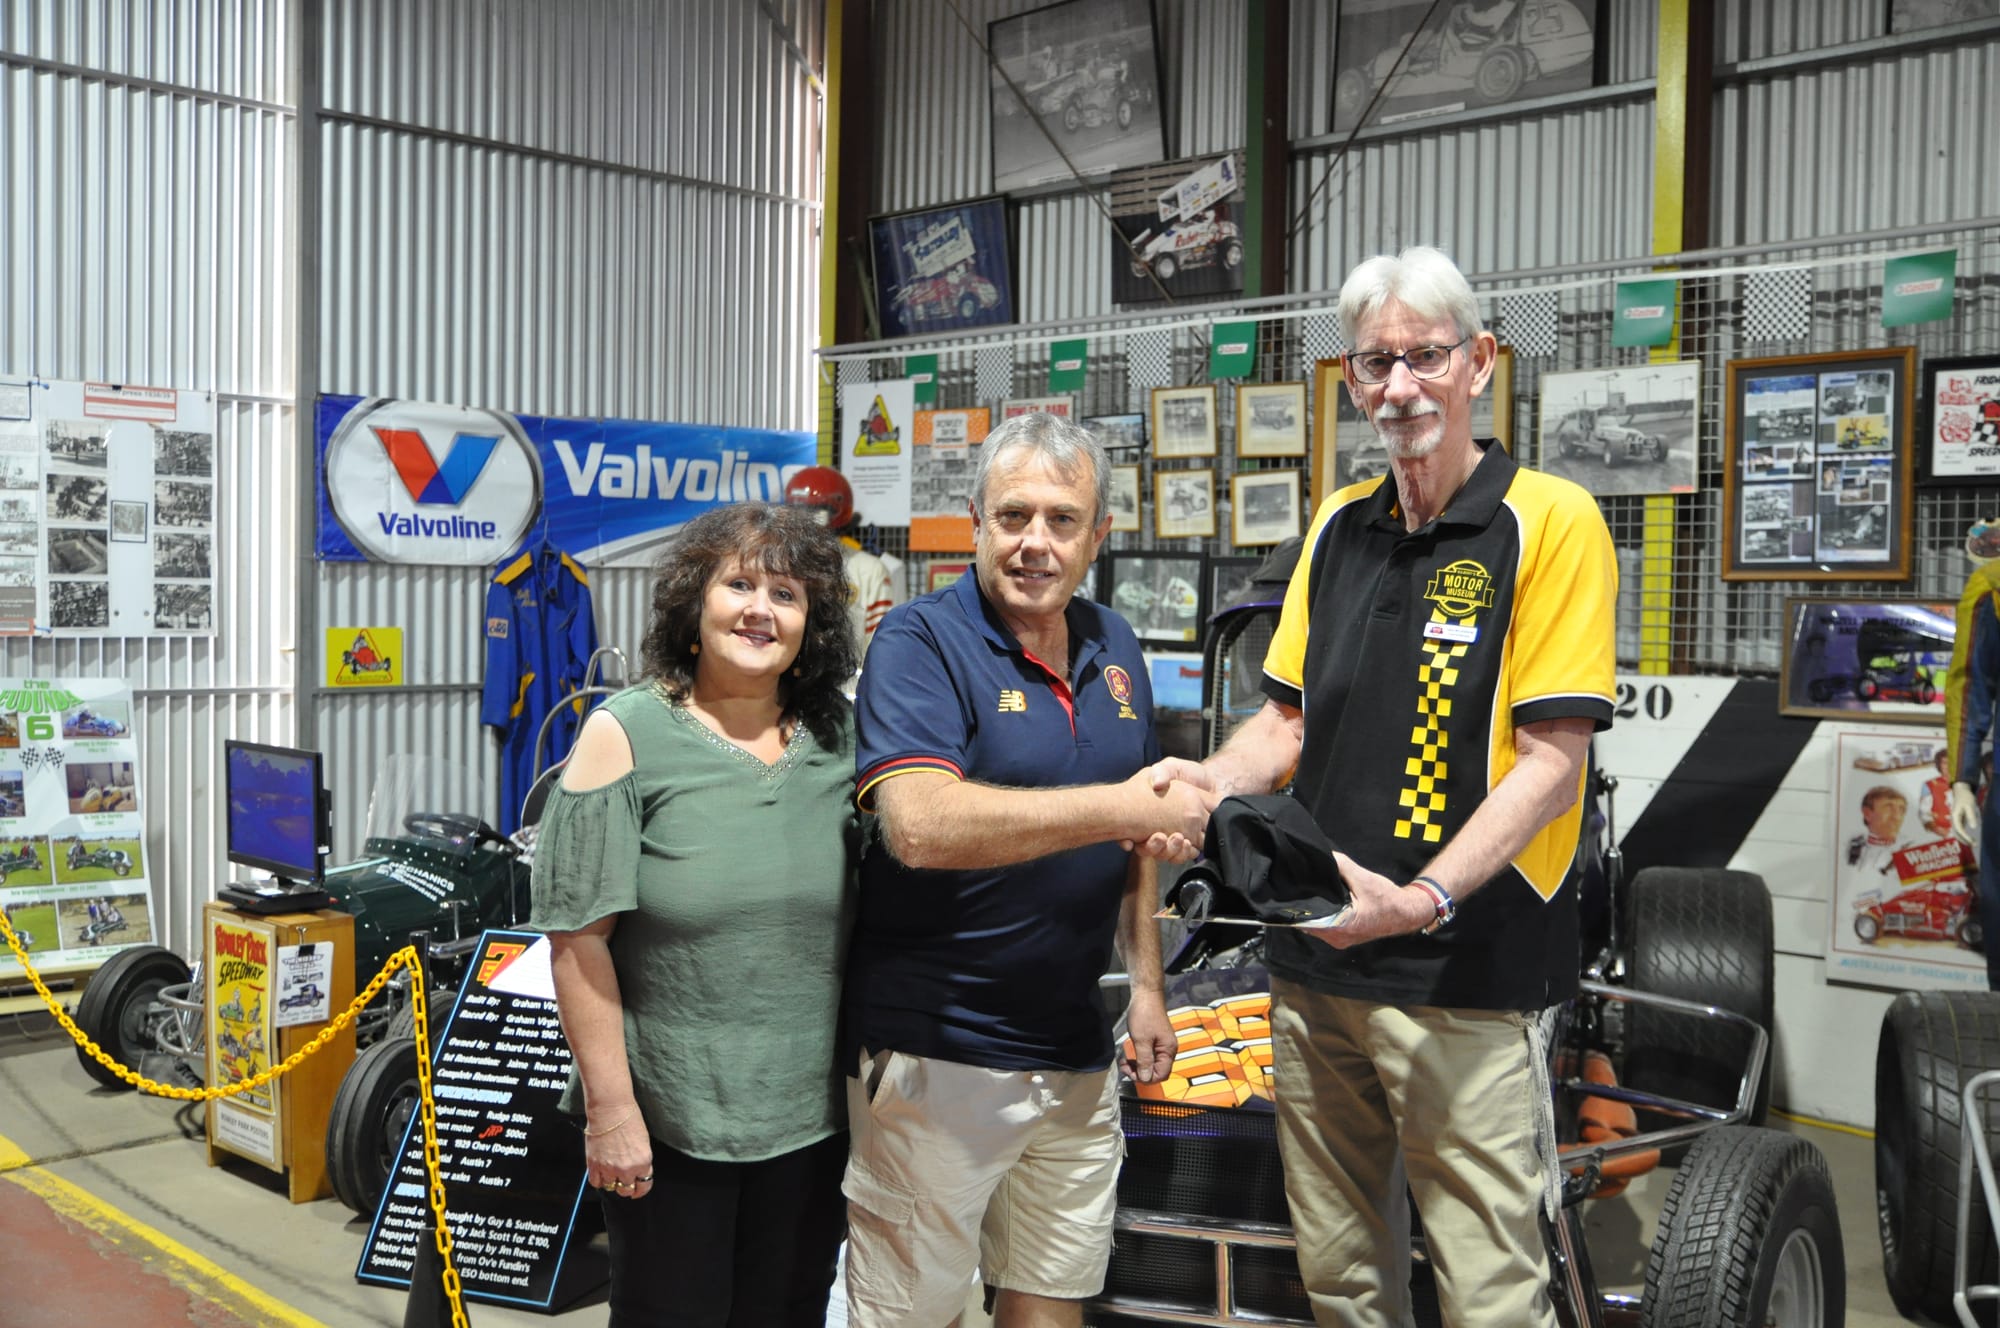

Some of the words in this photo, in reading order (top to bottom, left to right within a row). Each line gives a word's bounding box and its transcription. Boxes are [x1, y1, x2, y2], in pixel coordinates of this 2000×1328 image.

[378, 512, 496, 539] Valvoline
[1444, 574, 1484, 592] MOTOR
[1446, 587, 1477, 600] MUSEUM
[24, 680, 50, 689] the
[1614, 684, 1672, 720] 20
[26, 716, 54, 740] 6
[1904, 840, 1961, 866] Winfield
[218, 961, 264, 988] SPEEDWAY
[512, 998, 541, 1009] Graham
[506, 1014, 536, 1025] Graham
[456, 1108, 480, 1118] motor
[450, 1124, 475, 1134] motor
[384, 1214, 404, 1227] from
[456, 1226, 468, 1238] By
[468, 1227, 486, 1239] Jack
[488, 1230, 511, 1242] Scott
[512, 1234, 526, 1244] for
[388, 1202, 418, 1216] Second
[444, 1209, 474, 1223] bought
[474, 1212, 486, 1226] by
[488, 1216, 504, 1228] Guy
[505, 1218, 513, 1228] &
[514, 1219, 559, 1234] Sutherland
[375, 1240, 401, 1254] Motor
[456, 1252, 477, 1265] from
[379, 1228, 415, 1242] Repayed
[456, 1240, 486, 1254] money
[485, 1242, 498, 1256] by
[498, 1245, 512, 1256] Jim
[371, 1254, 413, 1272] Speedway
[478, 1270, 511, 1284] bottom
